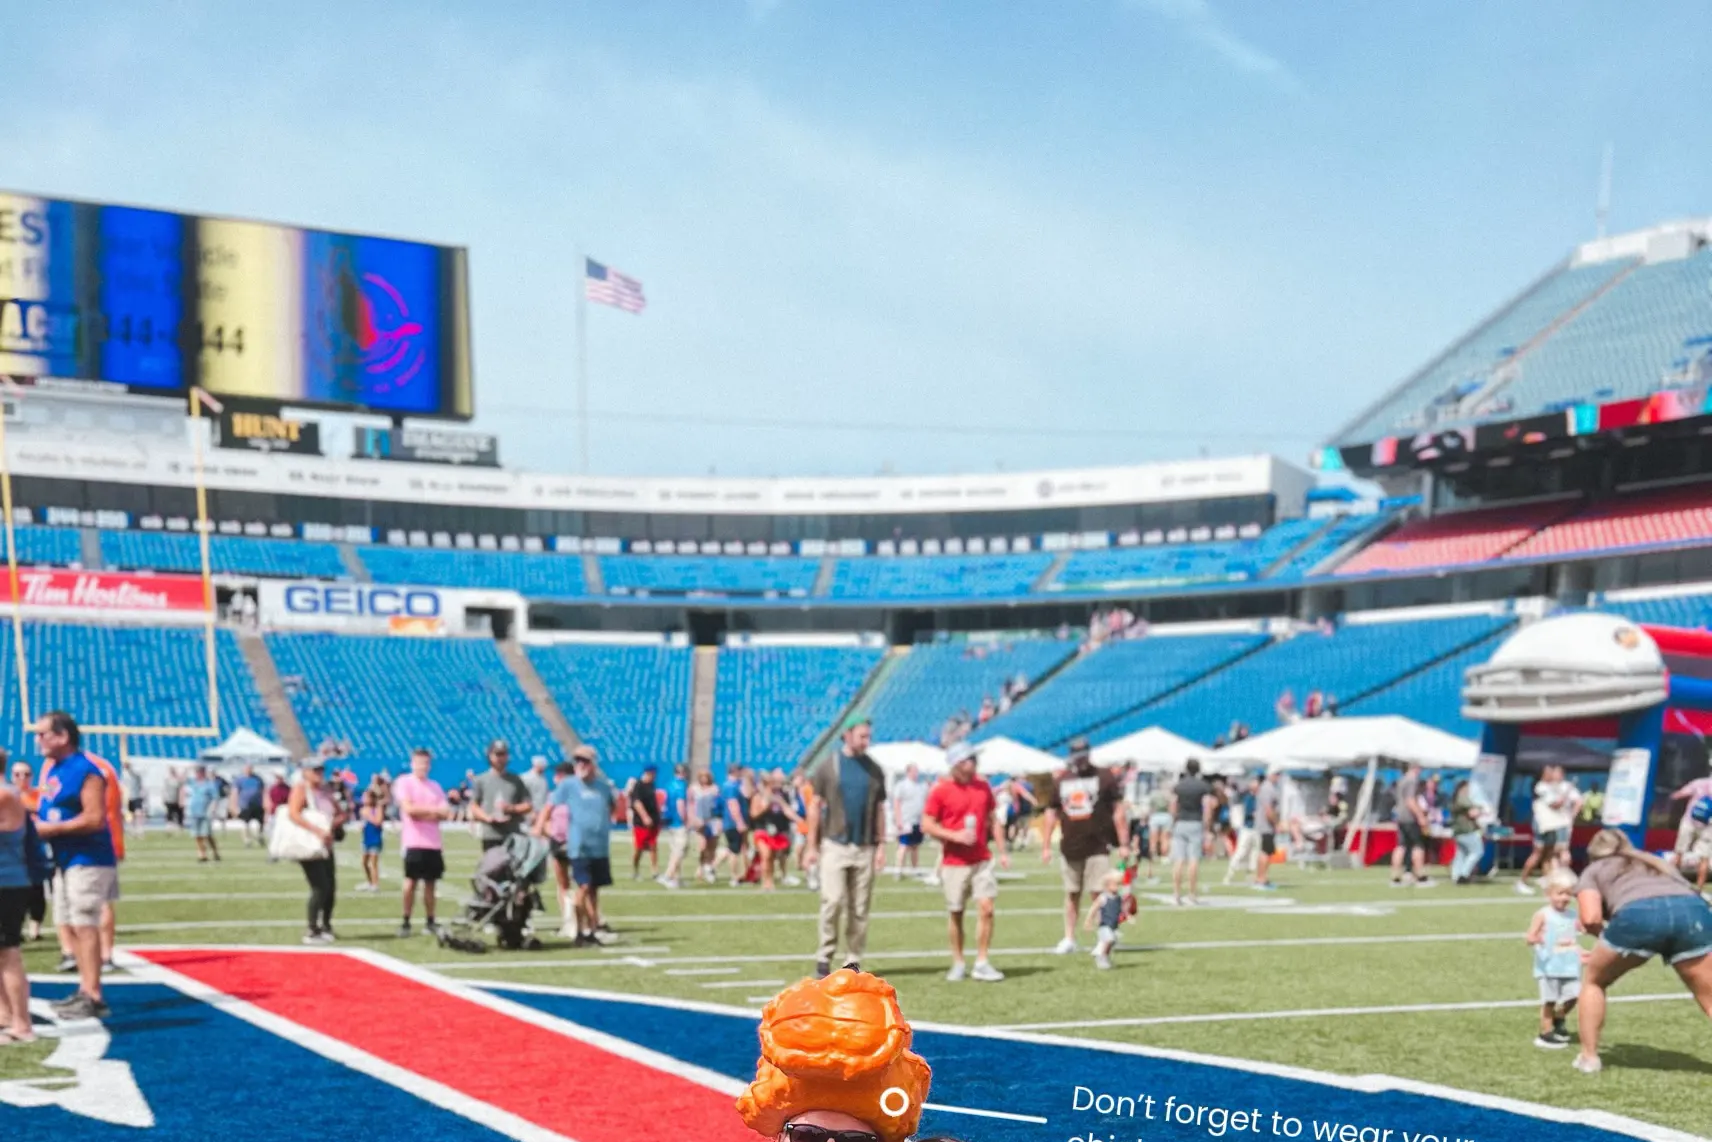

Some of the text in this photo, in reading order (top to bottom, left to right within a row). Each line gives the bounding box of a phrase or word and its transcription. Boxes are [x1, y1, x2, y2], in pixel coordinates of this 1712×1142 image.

[20, 573, 168, 608] Tim Hortons
[286, 586, 441, 617] GEICO
